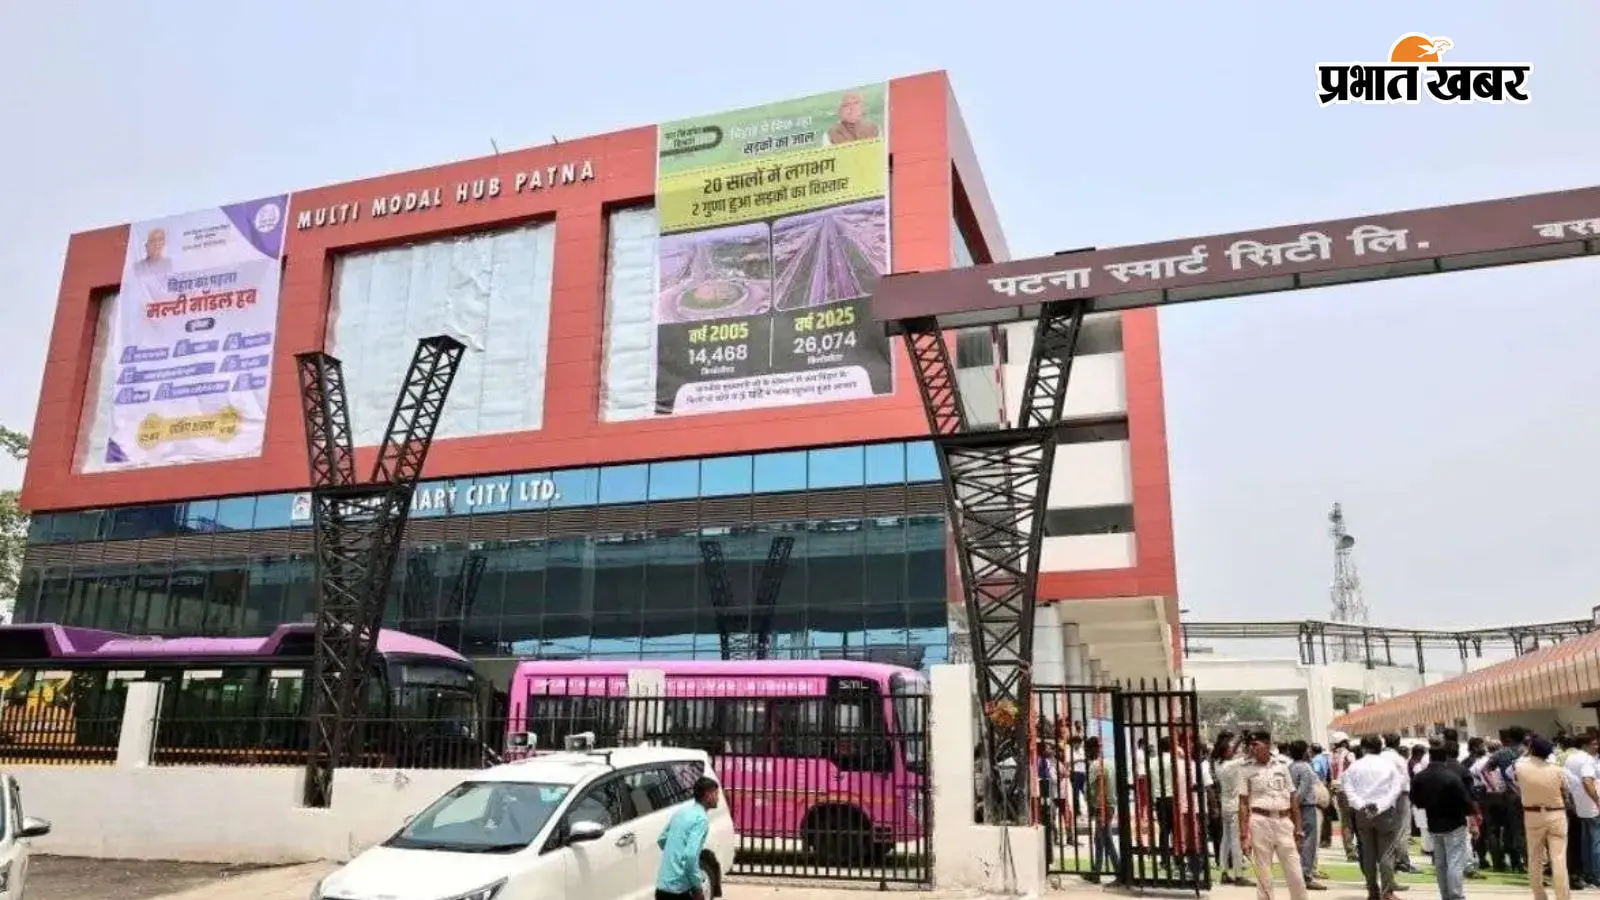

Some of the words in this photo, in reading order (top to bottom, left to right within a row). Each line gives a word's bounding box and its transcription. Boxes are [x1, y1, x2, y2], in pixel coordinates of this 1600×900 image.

[704, 178, 722, 195] 20
[726, 167, 764, 191] सालों
[768, 165, 782, 184] में
[785, 158, 836, 181] लगभग
[297, 204, 360, 230] MULTI
[372, 188, 442, 218] MODAL
[456, 177, 501, 203] HUB
[515, 160, 595, 193] PATNA
[692, 203, 700, 217] 2
[702, 199, 726, 218] गुणा
[729, 196, 751, 213] हुआ
[791, 186, 806, 199] का
[988, 267, 1092, 297] पटना
[1103, 244, 1208, 283] स्मार्ट
[1225, 231, 1333, 271] सिटी
[1346, 224, 1430, 256] लि.
[147, 294, 186, 318] मल्टी
[190, 290, 233, 312] मॉडल
[236, 289, 257, 308] हब
[688, 324, 711, 344] वर्ष
[711, 322, 749, 342] 2005
[794, 312, 814, 332] वर्ष
[815, 307, 855, 329] 2025
[689, 344, 748, 366] 14,468
[793, 331, 857, 354] 26,074
[466, 482, 511, 506] CITY
[520, 479, 560, 503] LTD.
